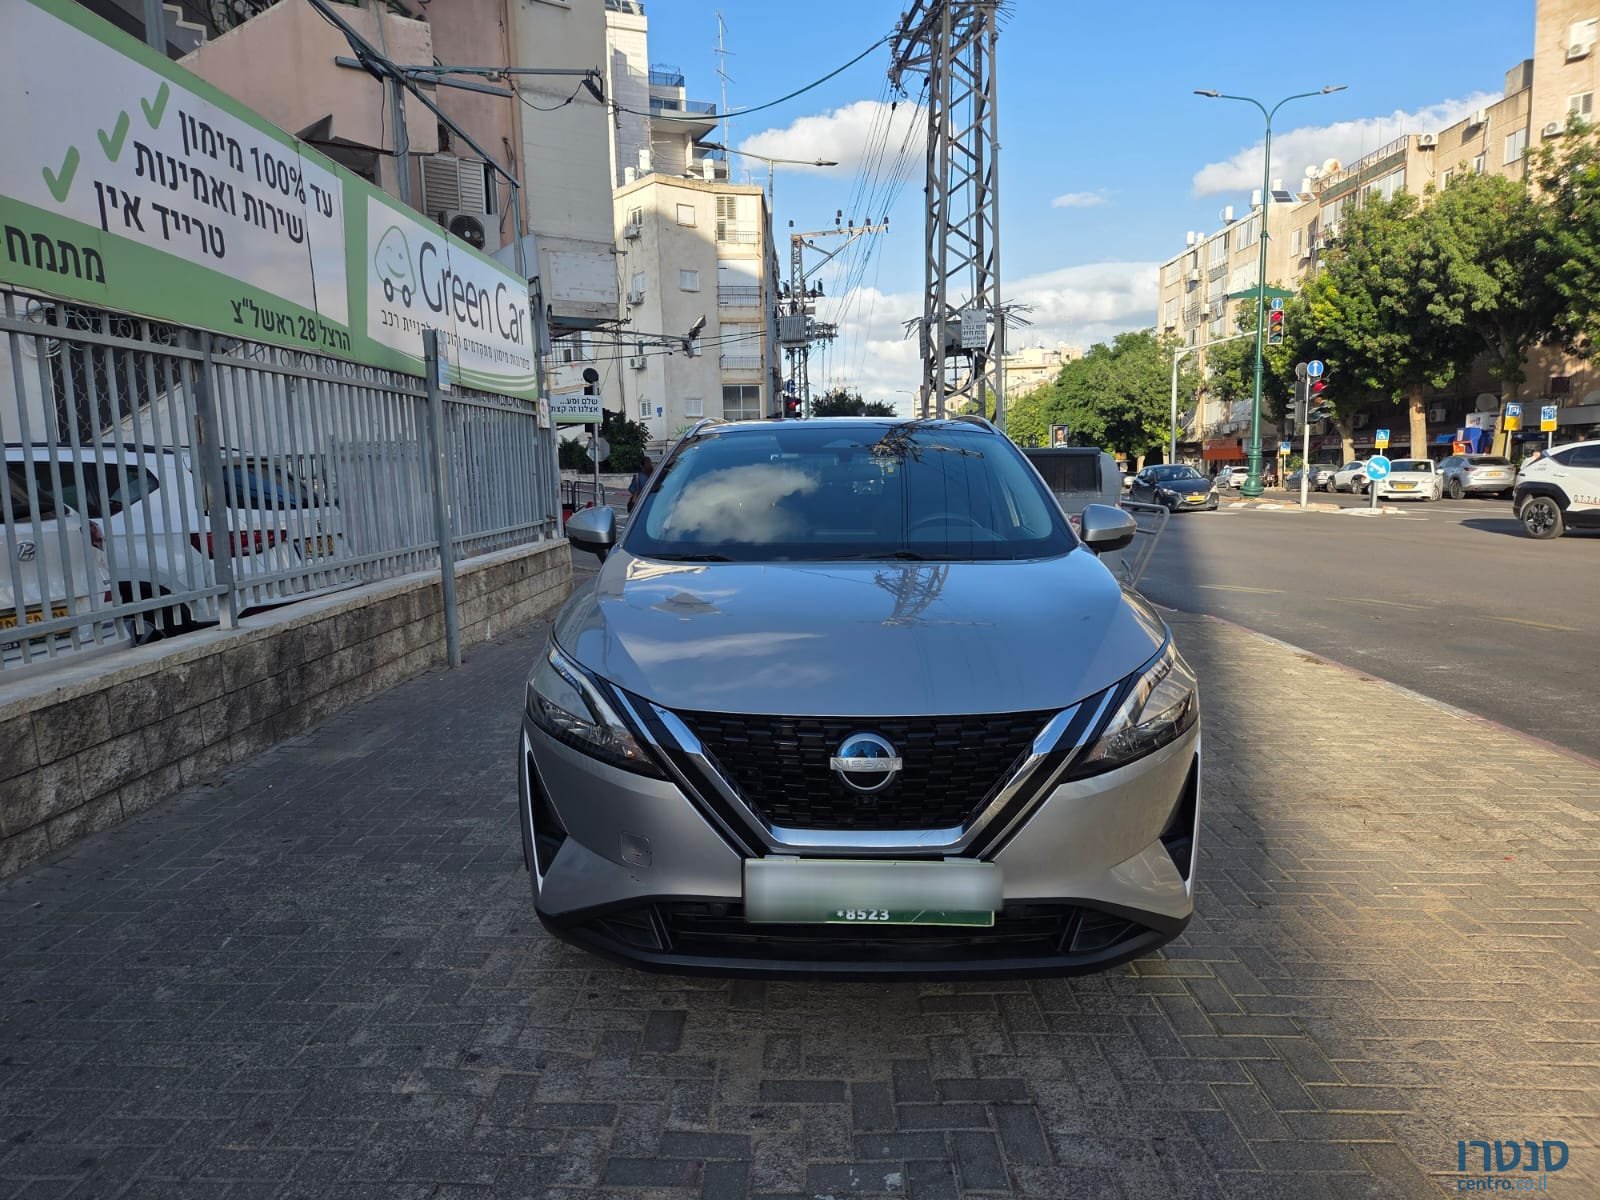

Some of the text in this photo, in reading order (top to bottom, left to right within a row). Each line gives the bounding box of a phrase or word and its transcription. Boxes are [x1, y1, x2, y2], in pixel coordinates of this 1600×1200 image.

[178, 110, 333, 218] עד 100% מימון
[133, 140, 304, 243] שירות ואמינות
[94, 181, 226, 258] טרייד אין
[0, 225, 106, 284] מתמח
[419, 241, 525, 346] Green Car
[298, 315, 317, 342] 28
[381, 309, 400, 329] רכב
[319, 319, 351, 351] הרצל
[463, 338, 493, 359] מתקדמים
[551, 406, 566, 414] קצת
[578, 405, 599, 413] אצלנו
[581, 397, 598, 405] שלם
[831, 758, 901, 770] NISSAN
